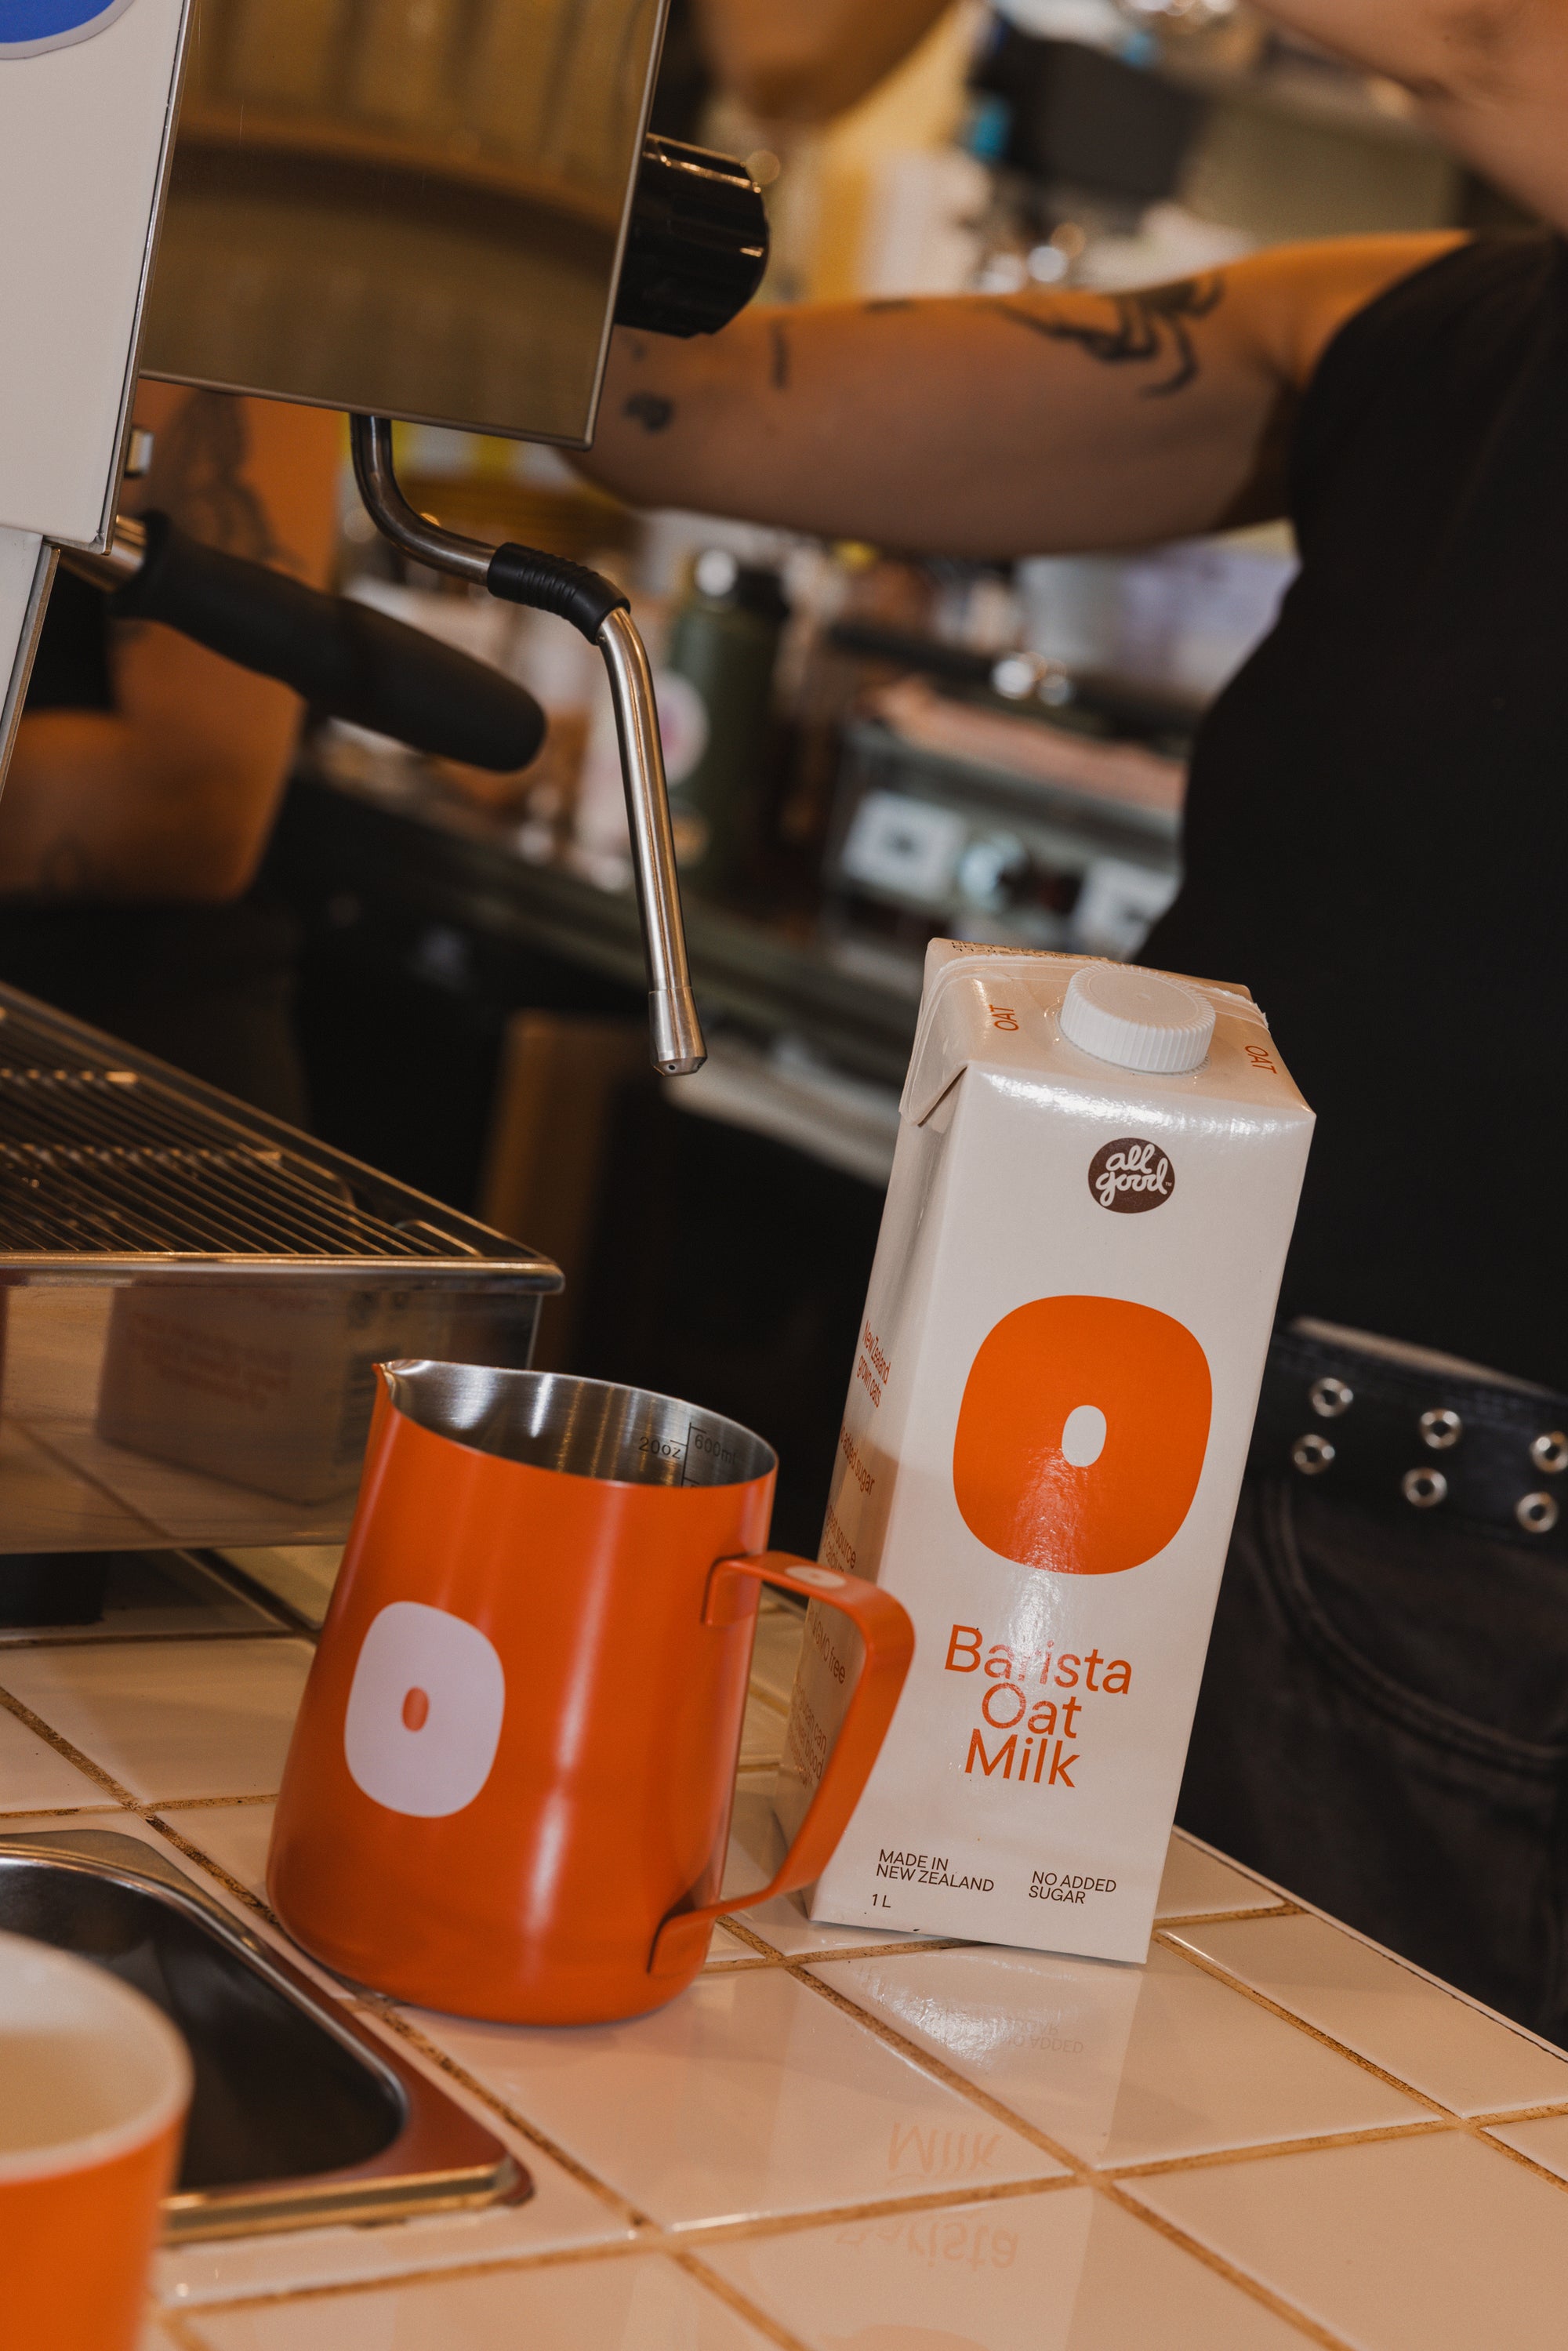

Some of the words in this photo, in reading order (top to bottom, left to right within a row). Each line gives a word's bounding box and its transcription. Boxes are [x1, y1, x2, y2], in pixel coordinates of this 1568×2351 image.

[989, 1004, 1019, 1032] OAT
[1244, 1044, 1278, 1074] OAT
[1105, 1144, 1156, 1174] all
[1095, 1157, 1169, 1206] good
[871, 1335, 891, 1386] Zealand
[855, 1458, 876, 1496] sugar
[829, 1646, 846, 1685] free
[945, 1624, 1132, 1695] Barista
[981, 1682, 1082, 1739] Oat
[964, 1728, 1080, 1788] Milk
[879, 1849, 928, 1869] MADE
[931, 1856, 949, 1871] IN
[876, 1863, 916, 1881] NEW
[917, 1870, 995, 1892] ZEALAND
[1032, 1870, 1058, 1886] NO
[1059, 1874, 1117, 1892] ADDED
[872, 1893, 878, 1907] 1
[882, 1895, 891, 1908] L
[1028, 1885, 1087, 1904] SUGAR
